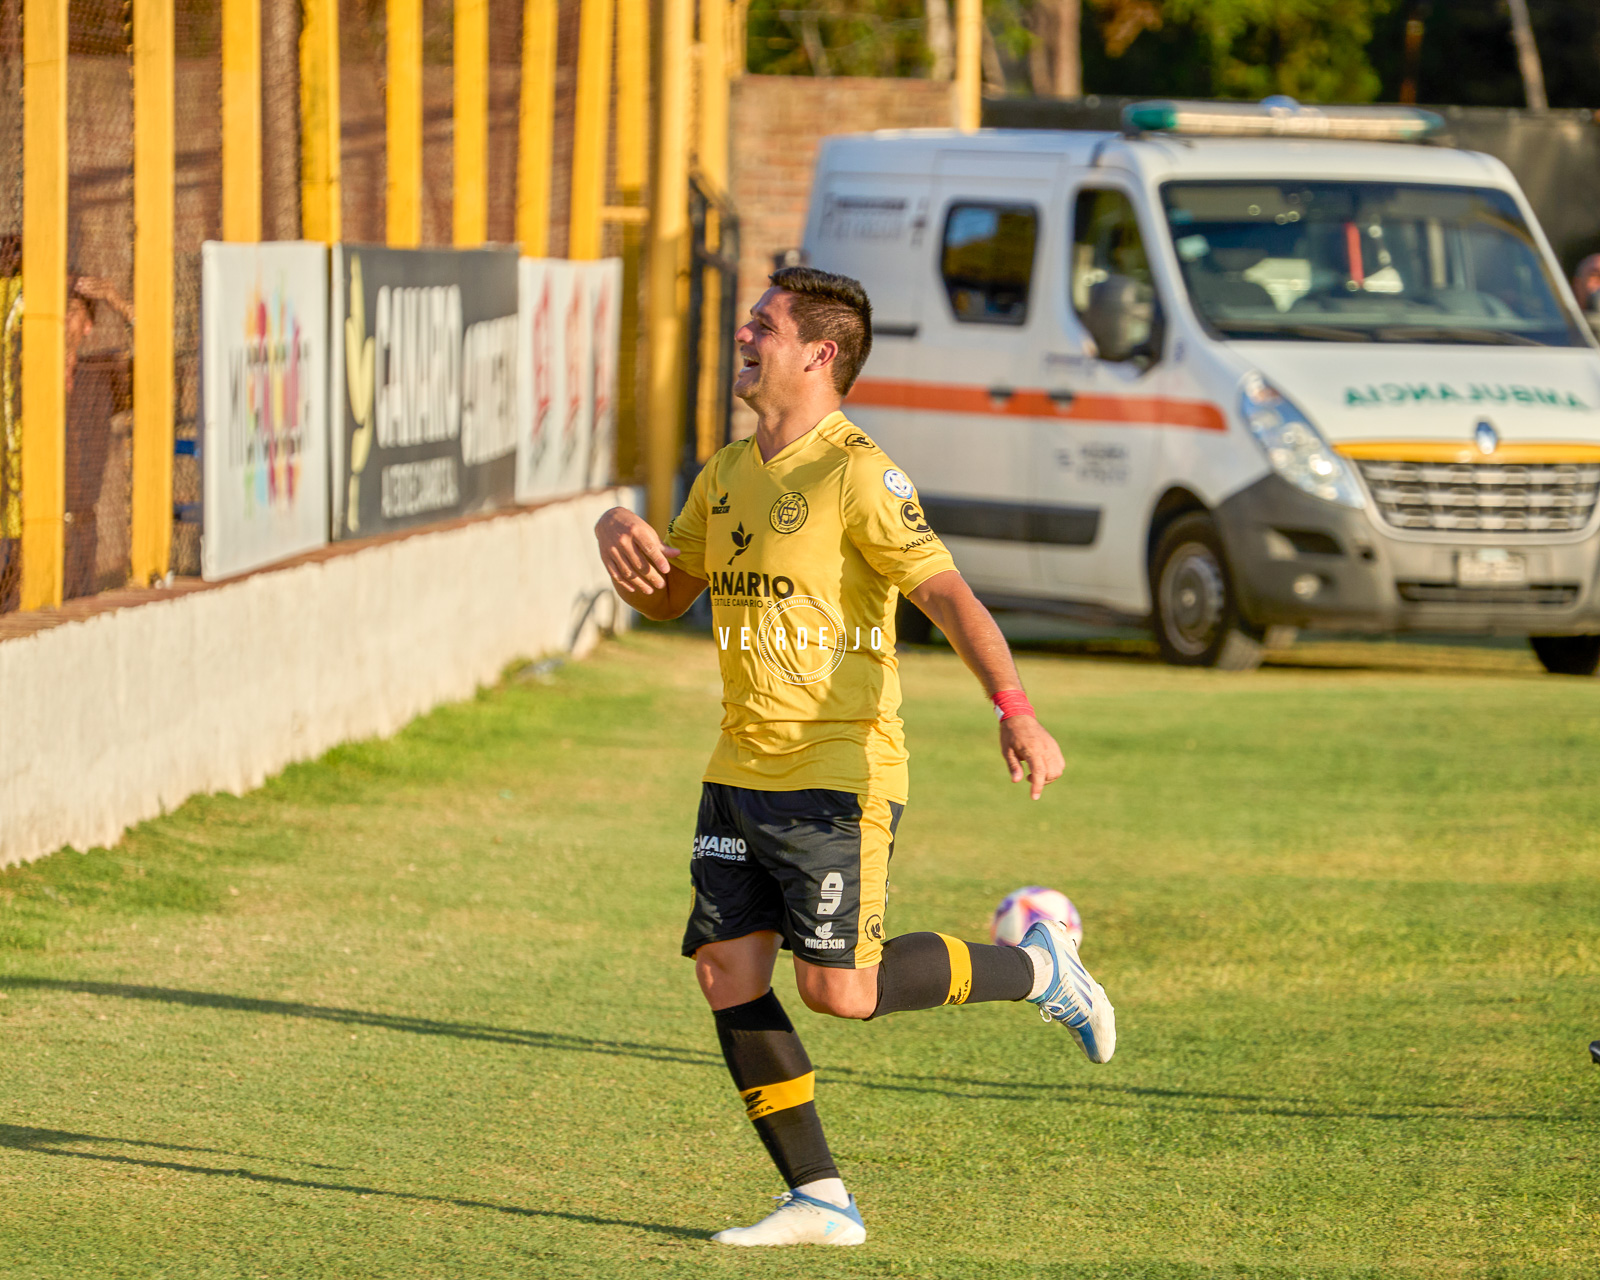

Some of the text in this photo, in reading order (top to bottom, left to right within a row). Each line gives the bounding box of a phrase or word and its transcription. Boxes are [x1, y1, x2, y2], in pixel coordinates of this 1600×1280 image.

[706, 571, 794, 600] ANARIO
[732, 598, 763, 608] CANARIO
[816, 872, 844, 915] 9
[804, 938, 845, 950] ANGEXIA
